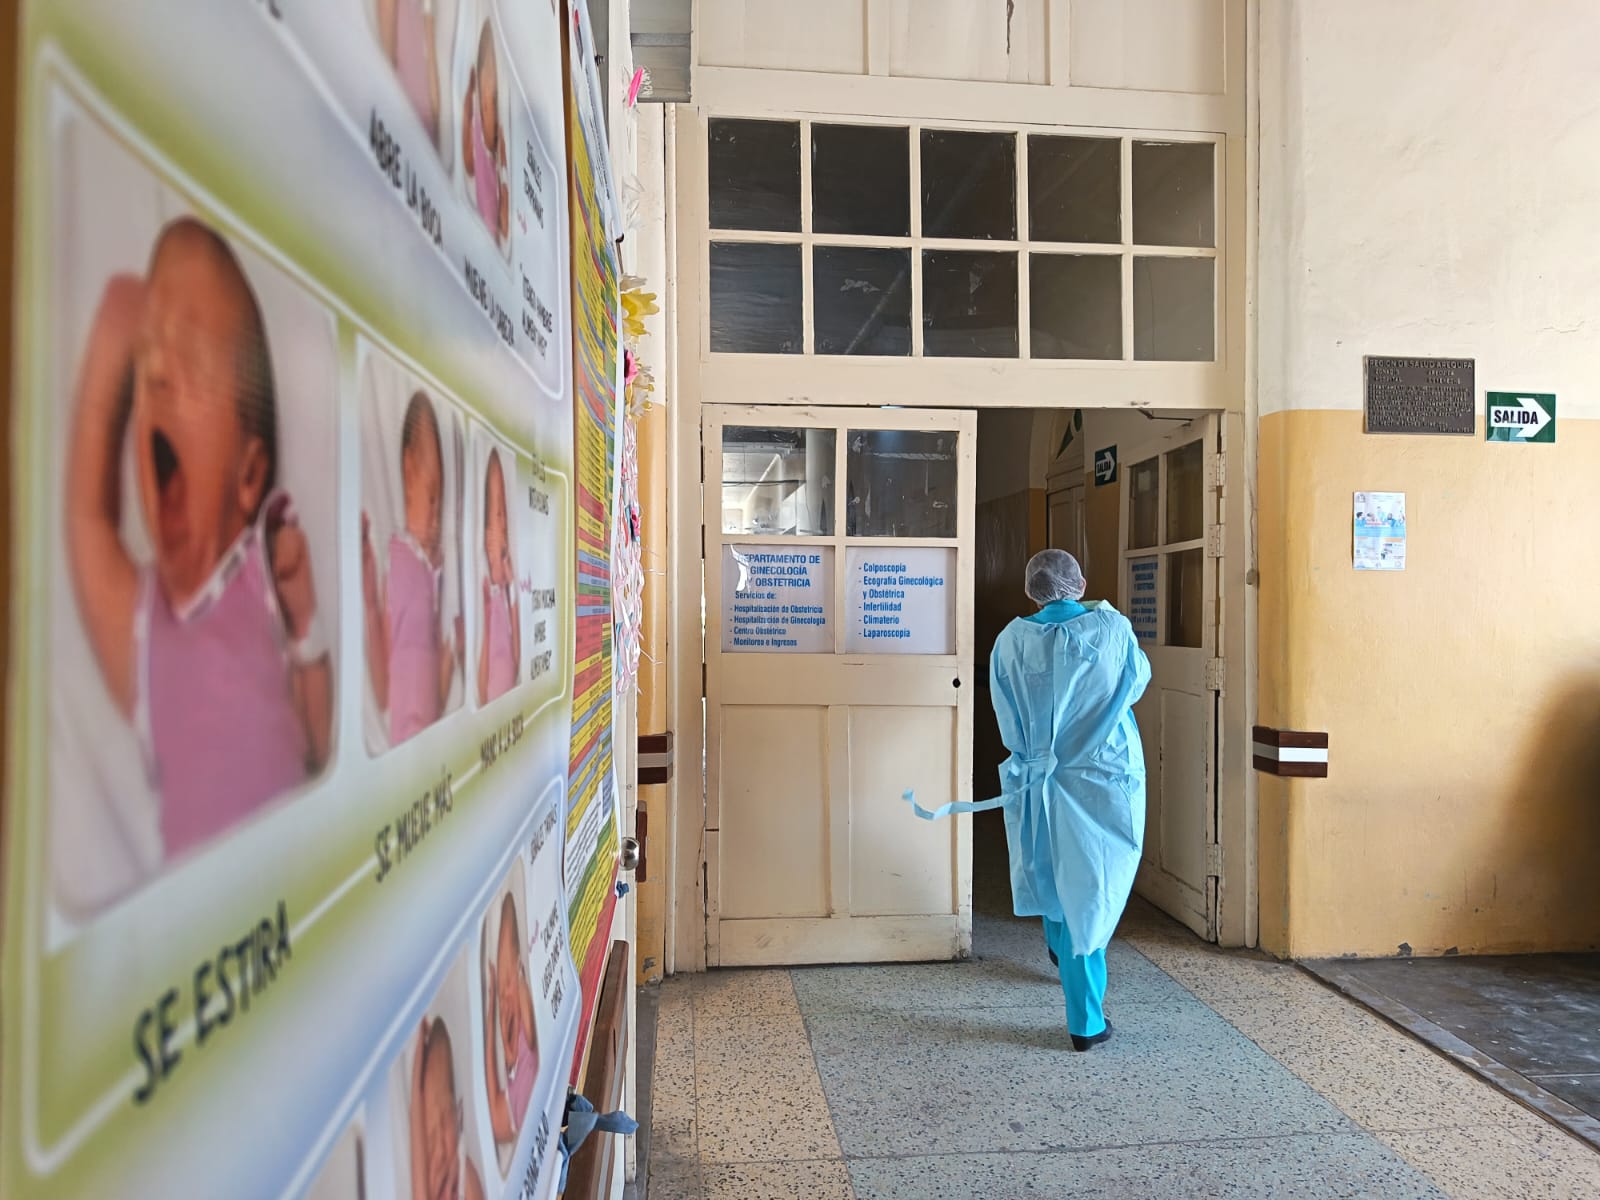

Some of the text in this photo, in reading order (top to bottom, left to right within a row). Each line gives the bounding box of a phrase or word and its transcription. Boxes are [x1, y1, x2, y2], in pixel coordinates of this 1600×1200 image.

[405, 160, 420, 216] LA
[1494, 409, 1539, 424] SALIDA
[809, 555, 821, 564] DE
[755, 577, 811, 587] OBSTETRICIA
[735, 590, 765, 600] Servicios
[862, 590, 867, 600] y
[863, 602, 902, 611] Infertilidad
[863, 614, 900, 624] Climaterio
[733, 626, 754, 635] Centro
[771, 638, 798, 648] Ingresos
[375, 824, 393, 884] SE
[396, 791, 431, 864] MUEVE
[133, 899, 291, 1104] SE ESTIRA
